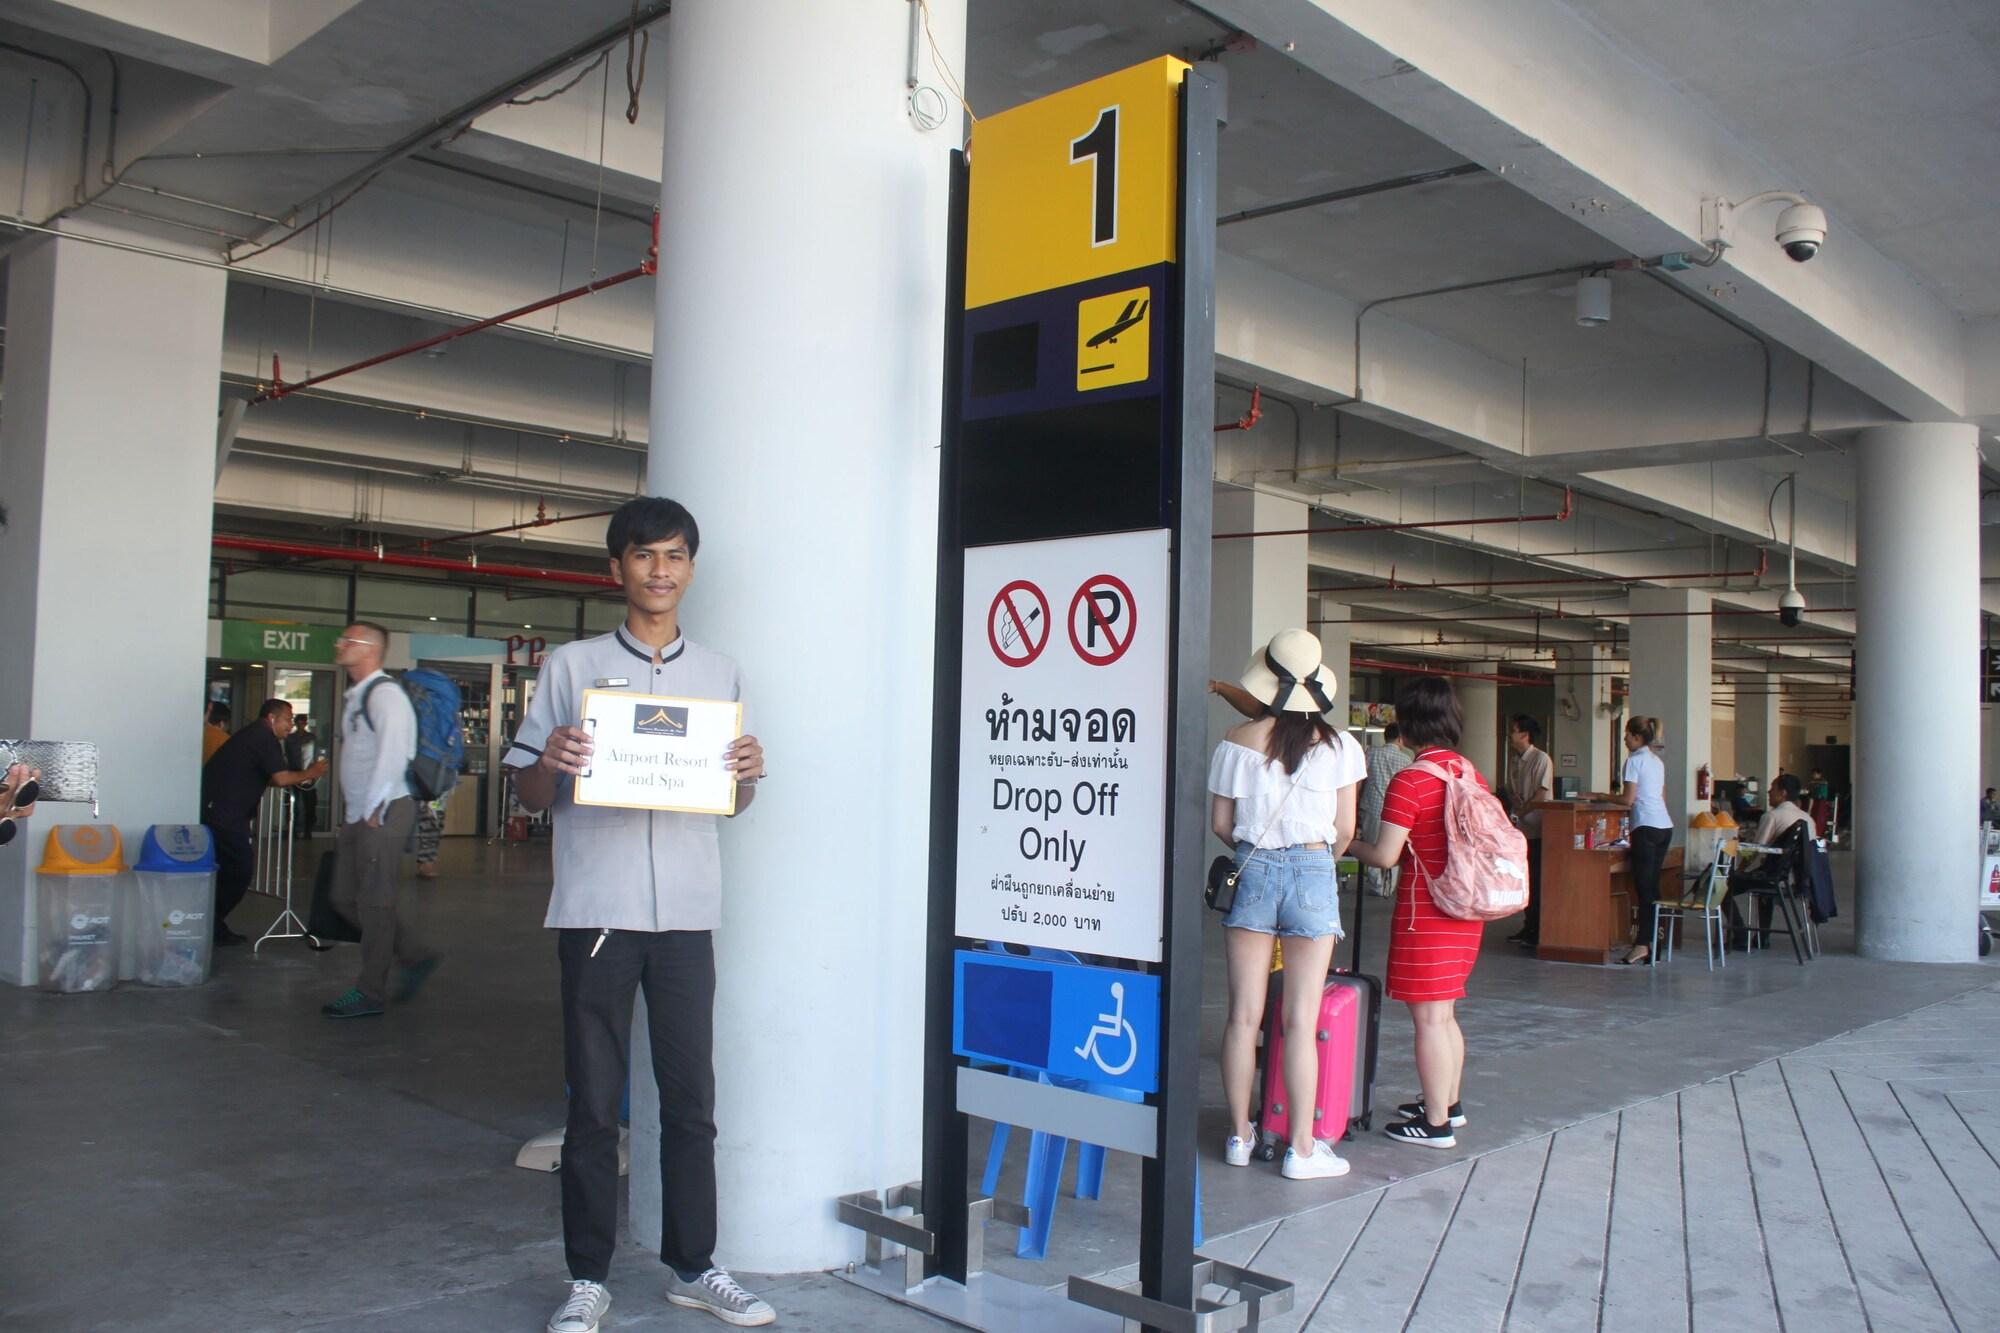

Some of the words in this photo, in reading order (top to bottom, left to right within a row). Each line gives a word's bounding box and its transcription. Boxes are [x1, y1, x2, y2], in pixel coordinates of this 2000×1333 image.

[1069, 103, 1120, 248] 1
[263, 630, 310, 651] EXIT
[985, 692, 1136, 743] ห้ามจอด
[607, 748, 659, 767] Airport
[664, 751, 709, 769] Resort
[989, 747, 1129, 772] หยุดเฉพาะรับ-ส่งเท่านั้น
[627, 771, 654, 786] and
[659, 774, 685, 790] Spa
[993, 778, 1062, 821] Drop
[1073, 781, 1119, 816] Off
[1019, 826, 1087, 872] Only
[991, 873, 1115, 902] ฝ่าฝืนถูกยกเคลื่อนย้าย
[1001, 904, 1028, 923] ปรับ
[1074, 916, 1101, 931] บาท
